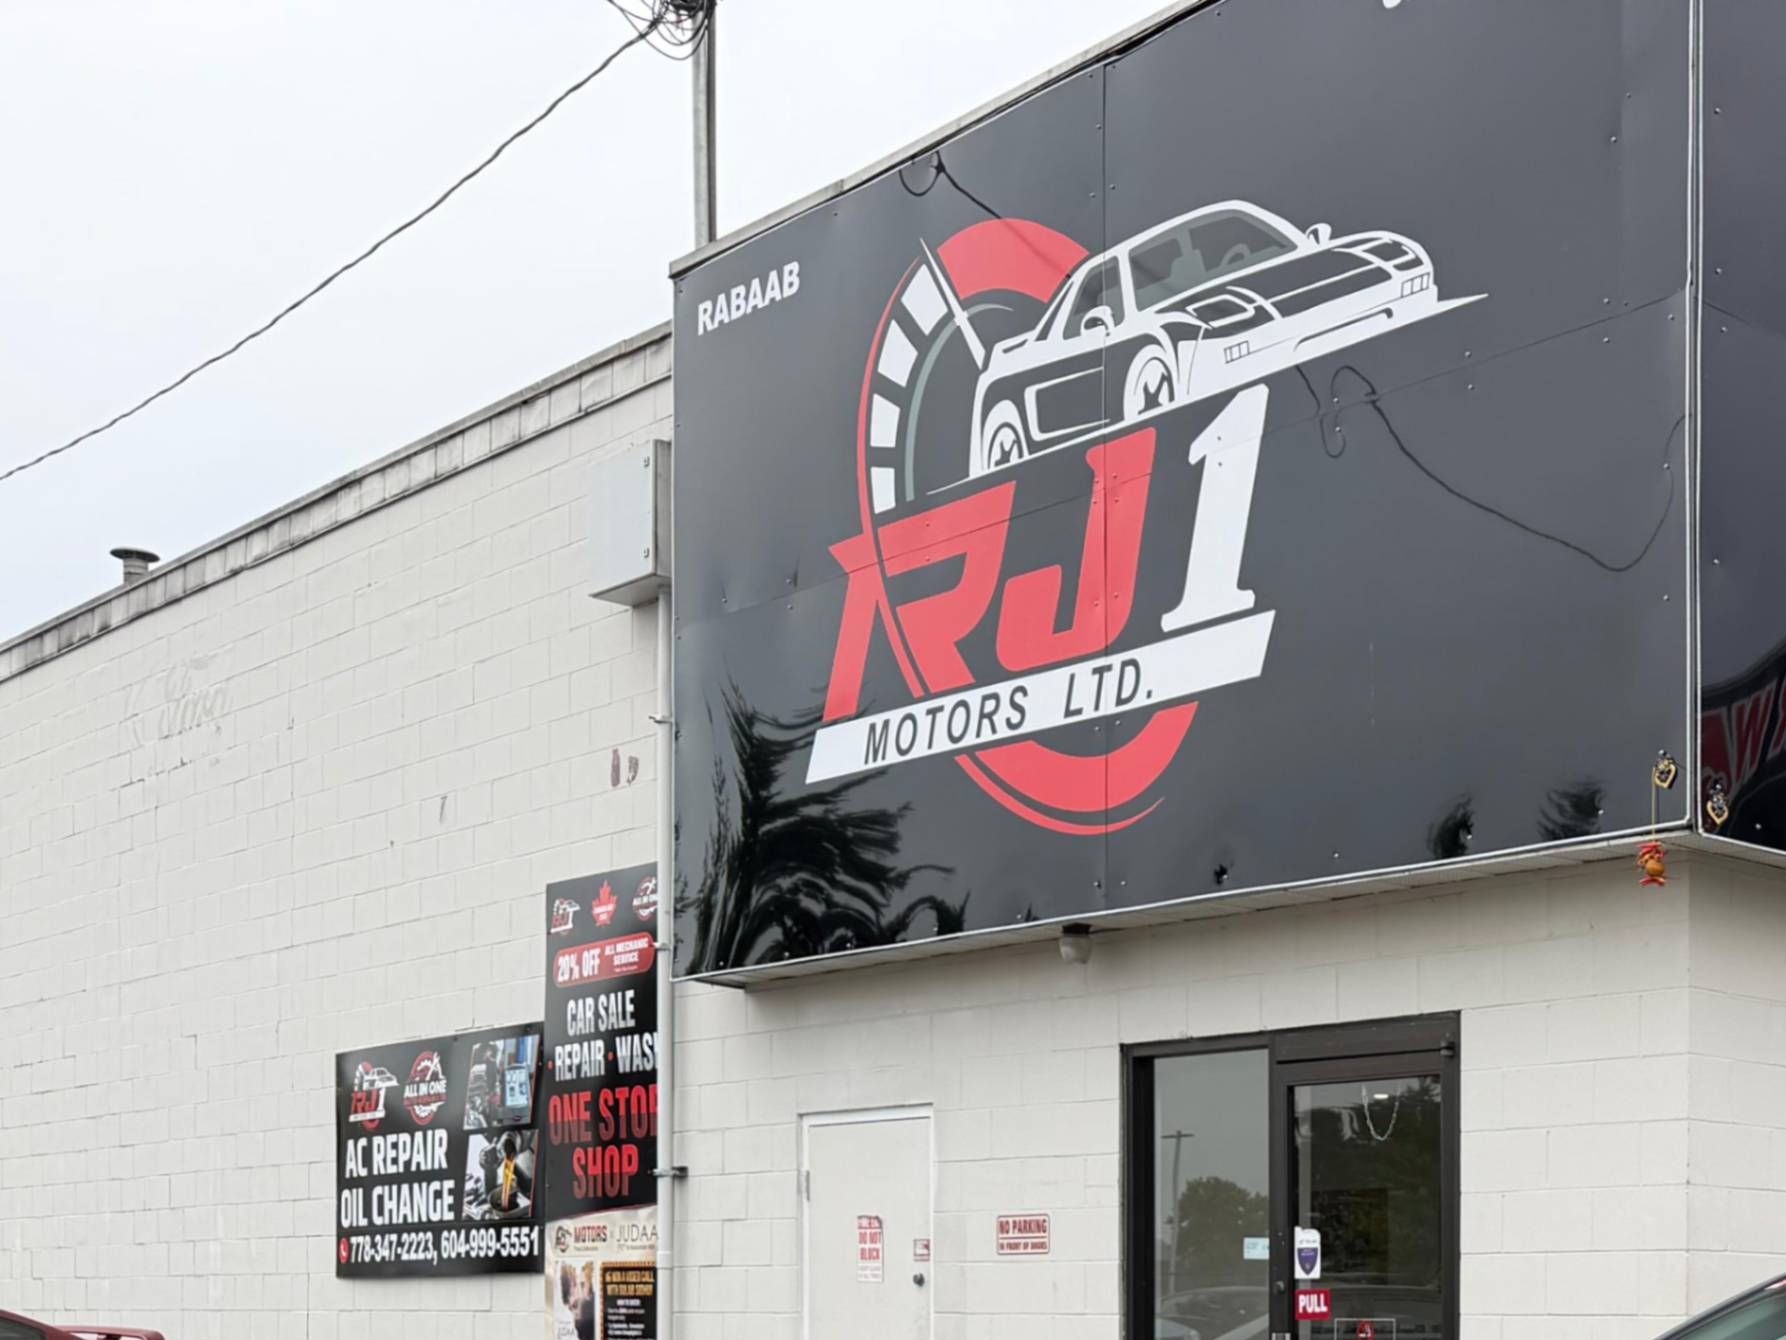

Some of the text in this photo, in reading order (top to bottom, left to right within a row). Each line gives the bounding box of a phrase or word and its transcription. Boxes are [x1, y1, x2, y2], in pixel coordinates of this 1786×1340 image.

[696, 260, 801, 337] RABAAB
[822, 383, 1270, 723] RJ1
[863, 657, 1155, 766] MOTORS LTD.
[557, 947, 601, 982] 20% OFF
[566, 988, 636, 1037] CAR SALE
[554, 1038, 606, 1082] REPAIR
[403, 1079, 447, 1099] ALL IN ONE
[548, 1090, 593, 1146] ONE
[345, 1128, 449, 1179] AC REPAIR
[572, 1143, 640, 1200] SHOP
[340, 1179, 455, 1229] OIL CHANGE
[1012, 1218, 1047, 1235] PARKING
[441, 1225, 540, 1260] 604-999-5551
[1298, 1292, 1329, 1314] PULL
